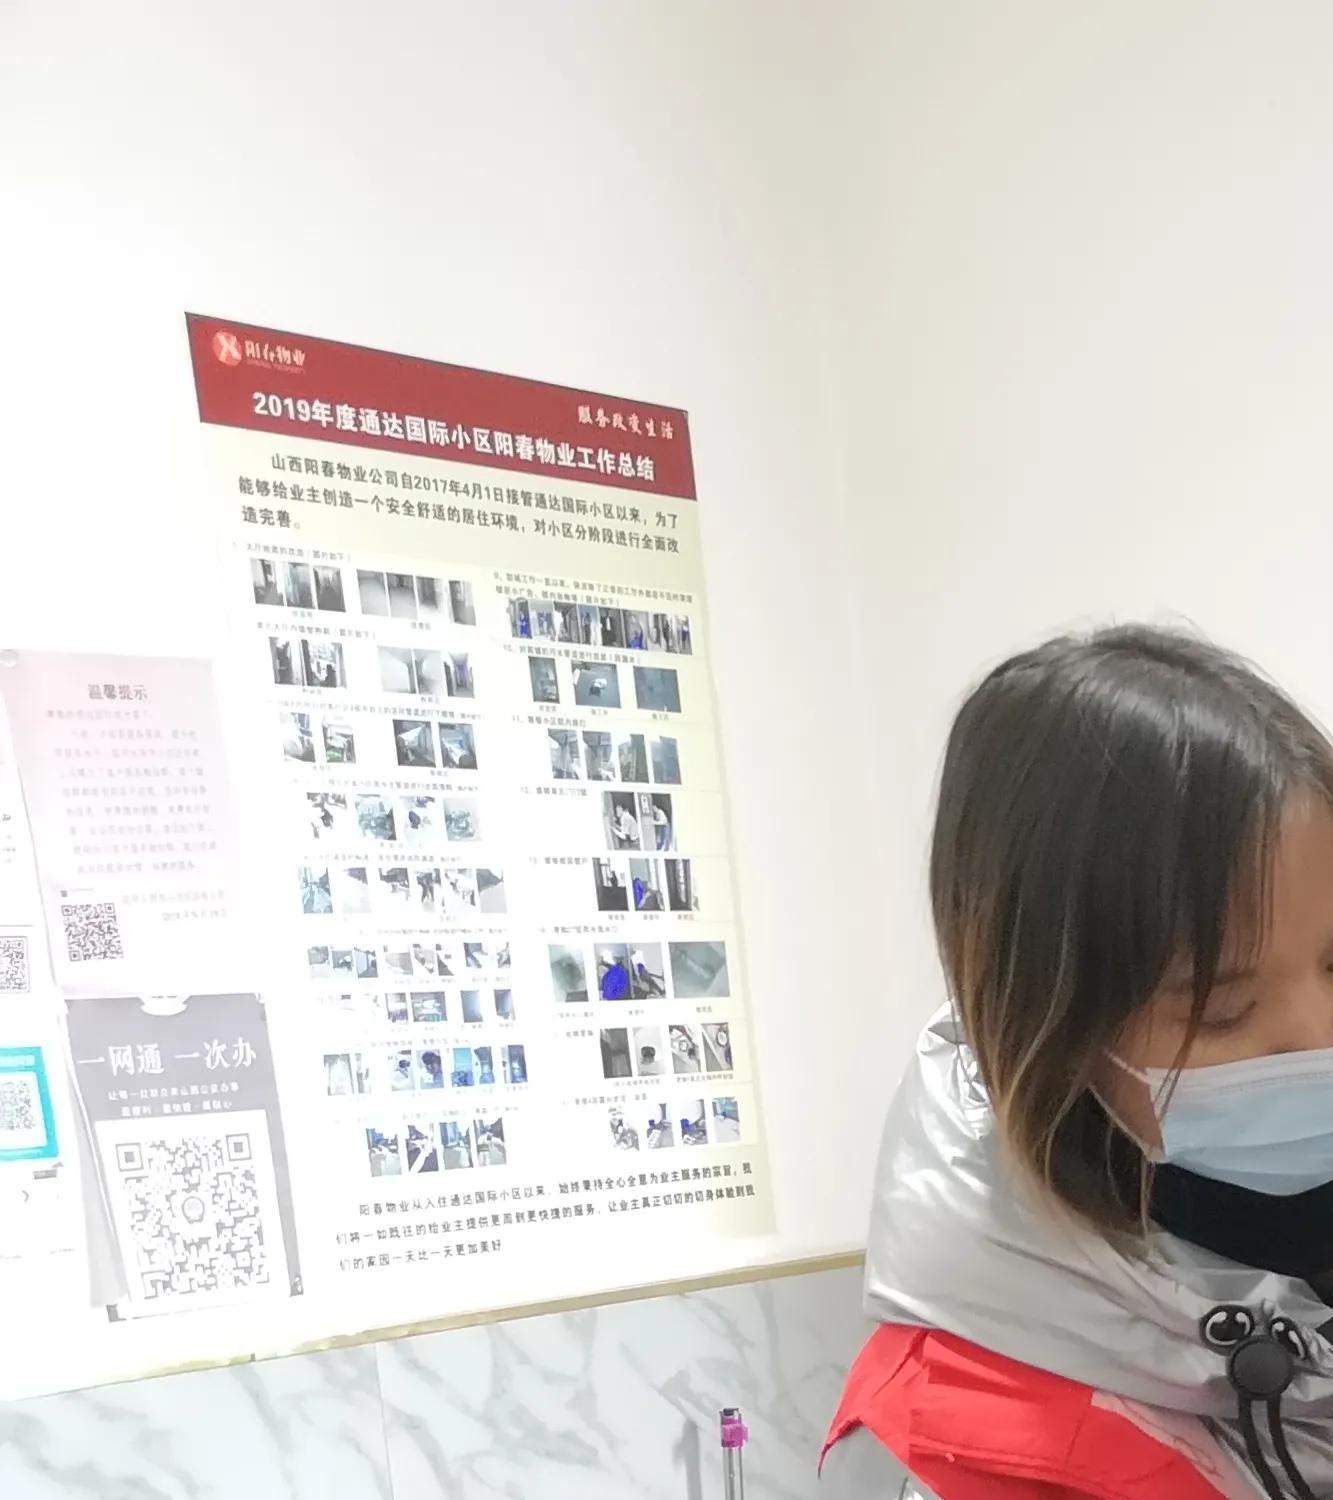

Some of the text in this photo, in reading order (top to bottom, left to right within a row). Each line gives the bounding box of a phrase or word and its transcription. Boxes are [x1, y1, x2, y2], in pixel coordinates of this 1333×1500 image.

[253, 391, 655, 481] 2019年度通达国际小区阳春物业工作总结
[77, 1036, 257, 1077] 一网通 一次办
